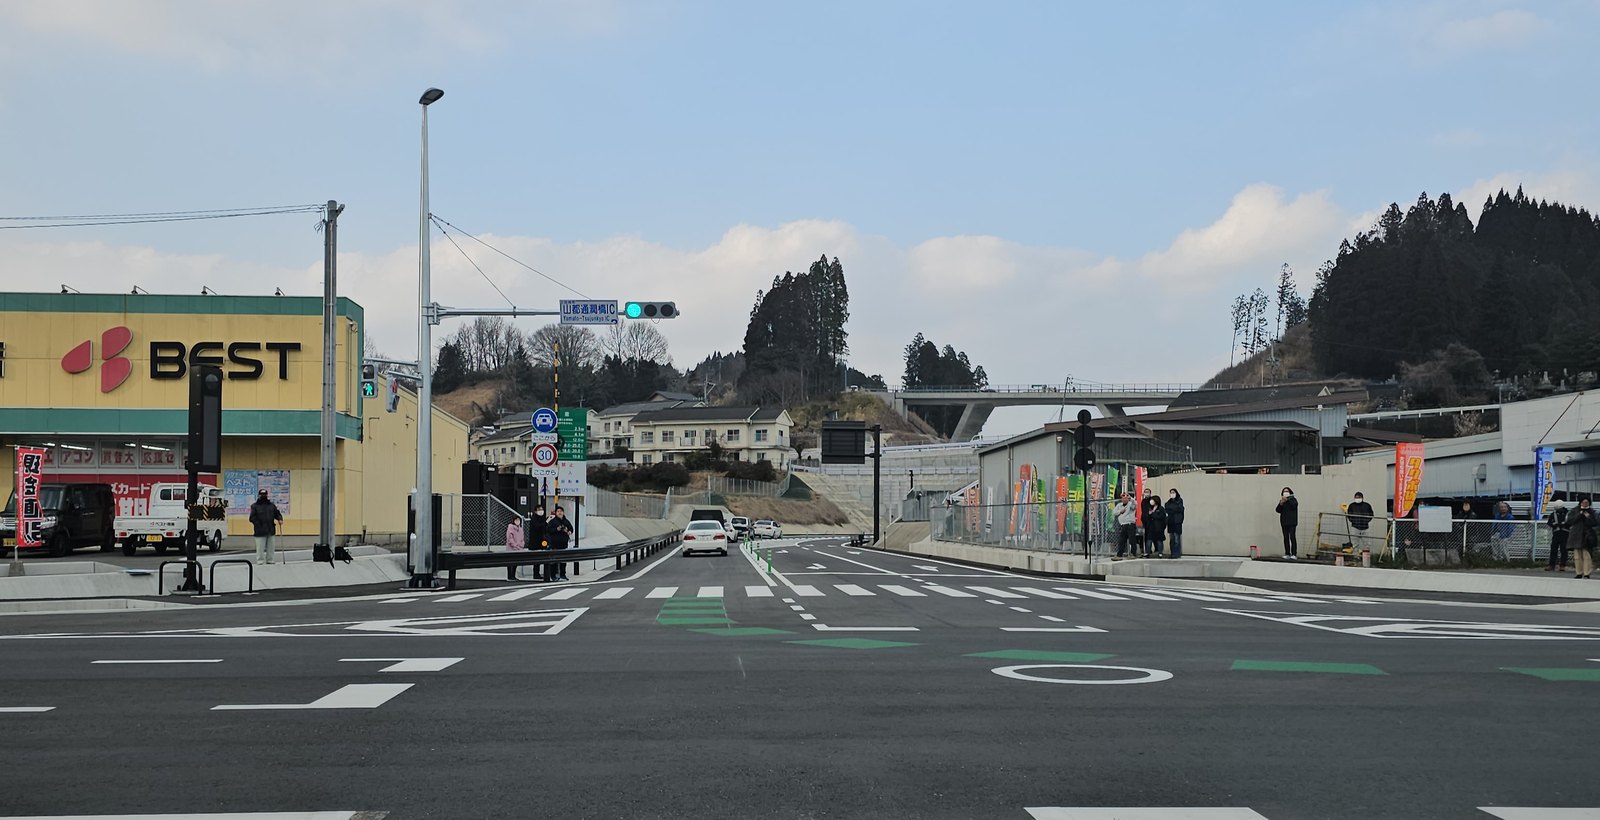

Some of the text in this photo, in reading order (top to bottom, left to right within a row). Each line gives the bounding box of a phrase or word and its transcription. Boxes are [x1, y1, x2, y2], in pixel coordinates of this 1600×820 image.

[563, 304, 616, 314] 山都通潤橋IC
[150, 341, 301, 380] BEST
[538, 450, 552, 461] 30
